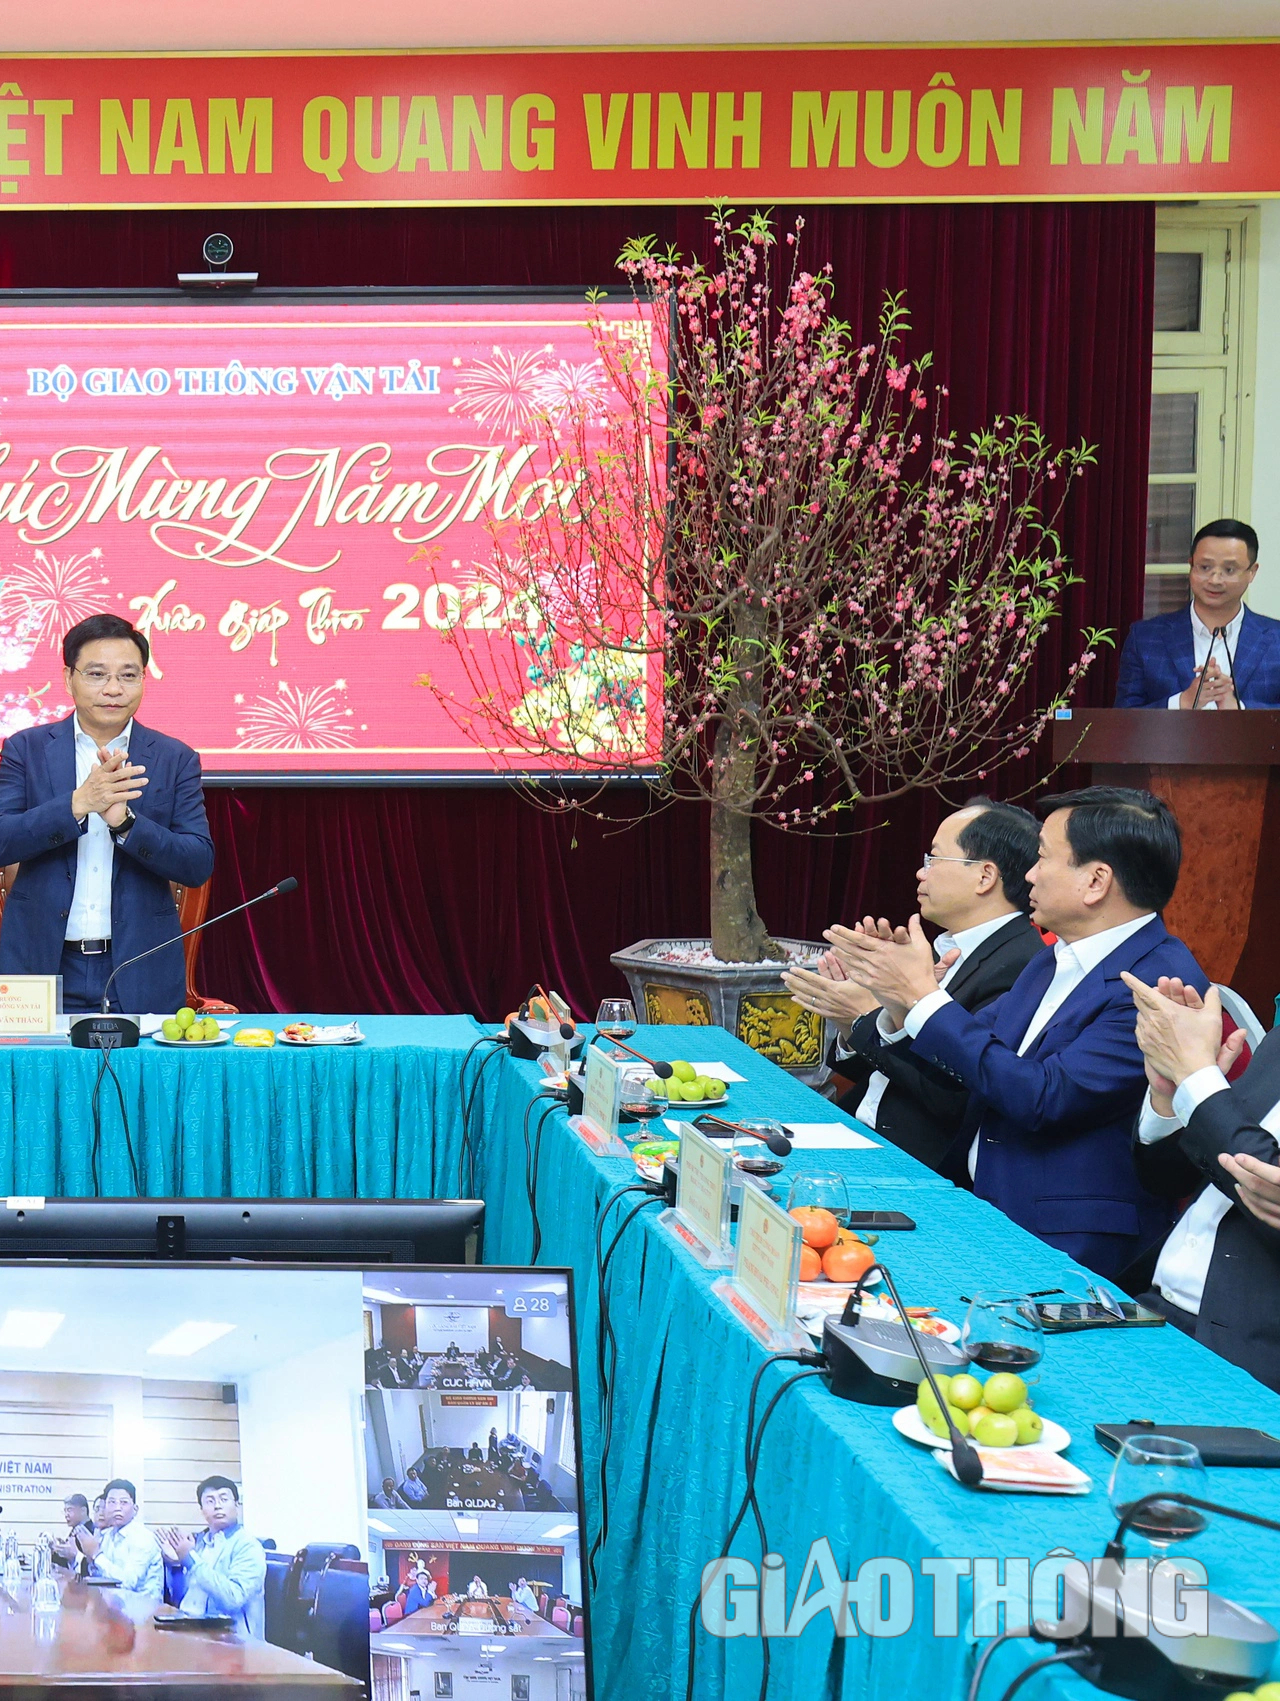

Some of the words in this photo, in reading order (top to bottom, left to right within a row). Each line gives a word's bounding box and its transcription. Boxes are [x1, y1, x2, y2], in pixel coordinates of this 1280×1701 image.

[99, 98, 274, 176] NAM
[302, 93, 556, 184] QUANG
[582, 92, 762, 171] VINH
[789, 71, 1023, 169] MUÔN
[1049, 69, 1234, 166] NĂM
[27, 364, 77, 402] BỘ
[83, 367, 172, 397] GIAO
[176, 360, 298, 396] THÔNG
[302, 363, 374, 401] VẬN
[380, 359, 441, 394] TẢI
[18, 445, 341, 573] Mừng
[381, 582, 545, 630] 2024
[530, 1297, 550, 1312] 28
[24, 1462, 53, 1475] NAM
[446, 1498, 463, 1507] Ban
[431, 1622, 447, 1631] Ban
